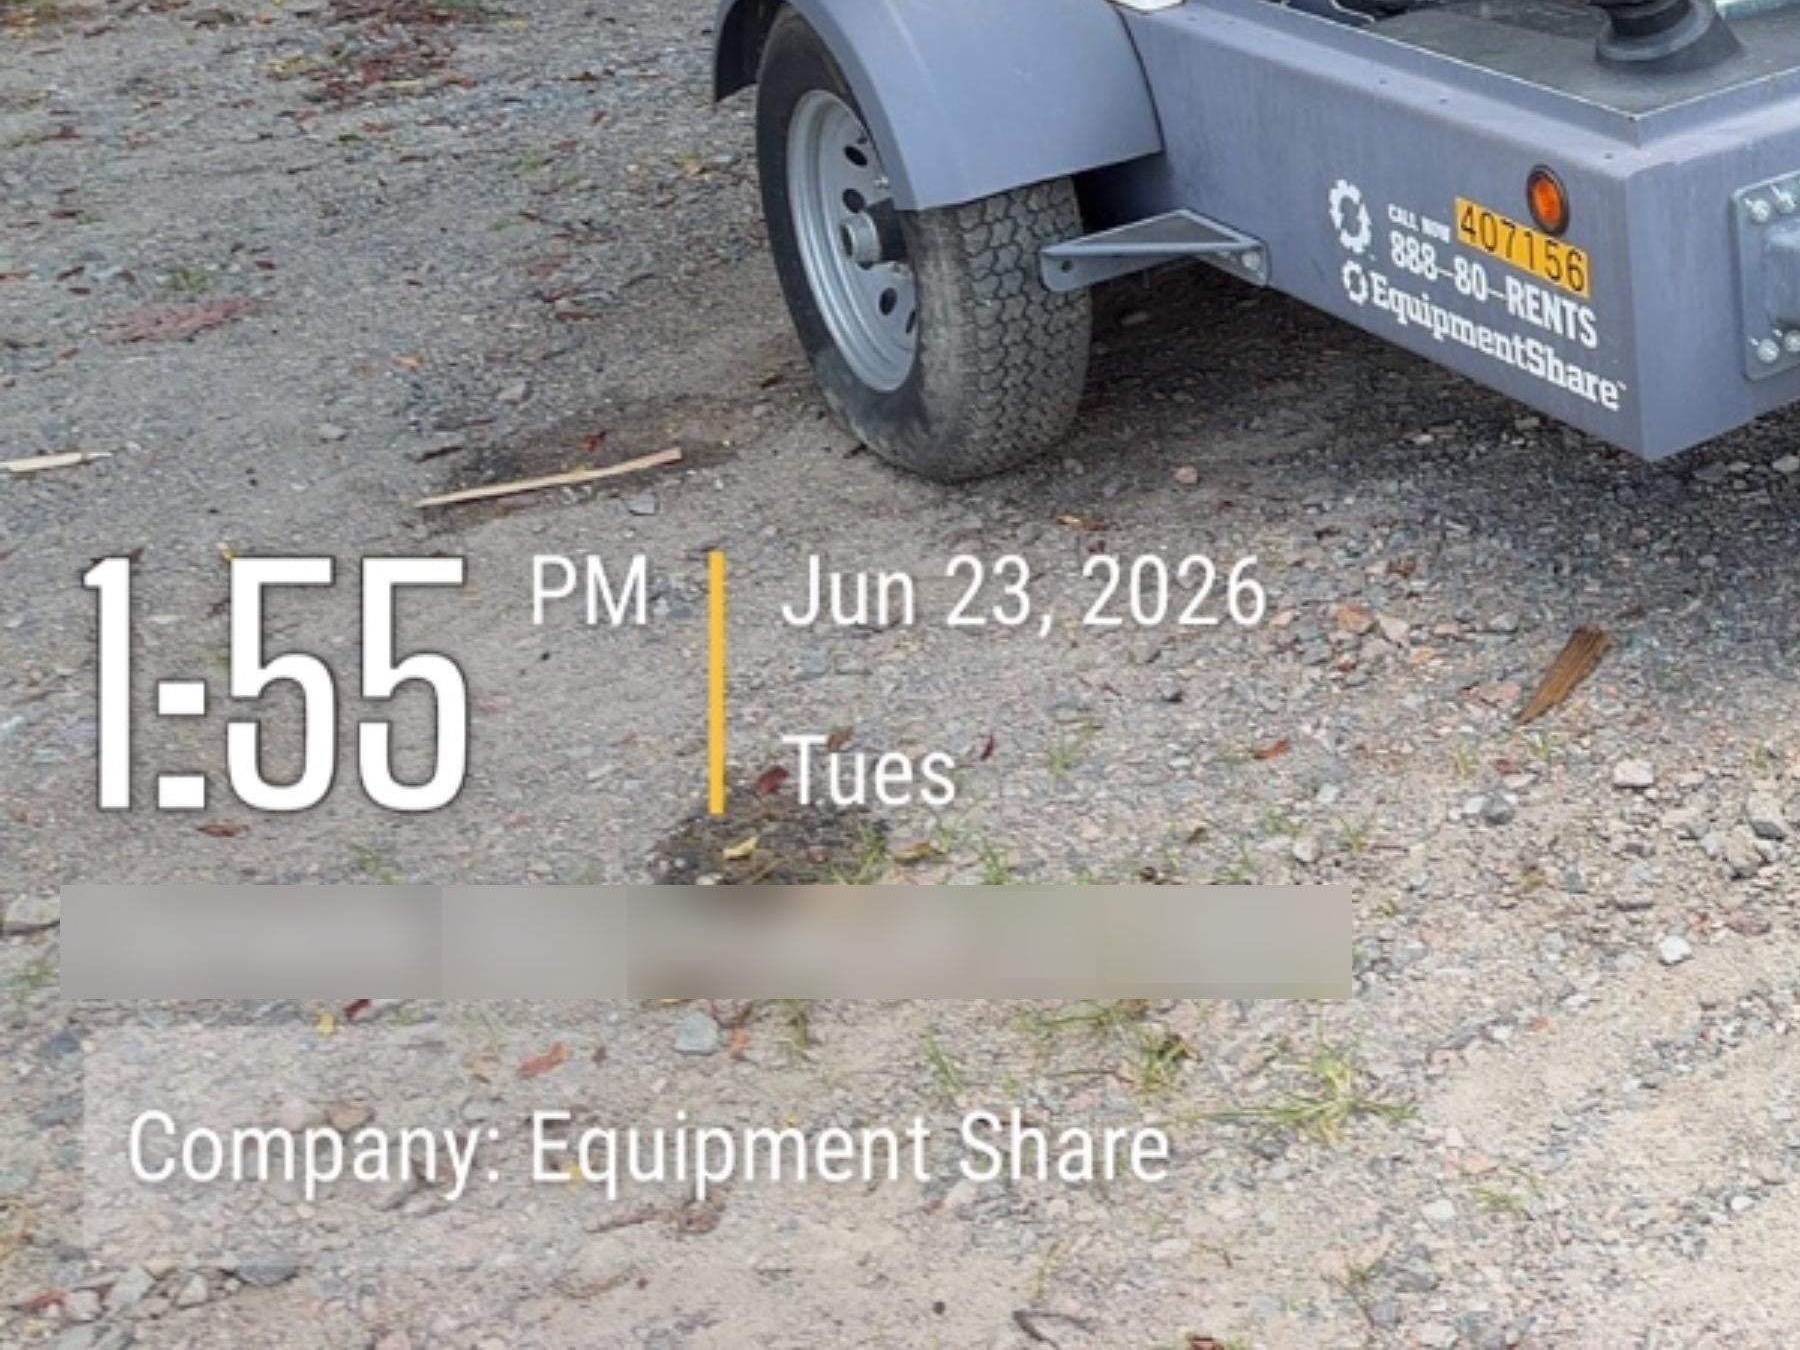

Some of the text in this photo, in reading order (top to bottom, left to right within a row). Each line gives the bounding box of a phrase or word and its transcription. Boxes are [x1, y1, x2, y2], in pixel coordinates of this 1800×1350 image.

[1388, 204, 1450, 243] CALL NOW
[1459, 206, 1586, 291] 407156
[1390, 231, 1599, 348] 888-80-RENTS
[1370, 272, 1620, 411] EquipmentShare
